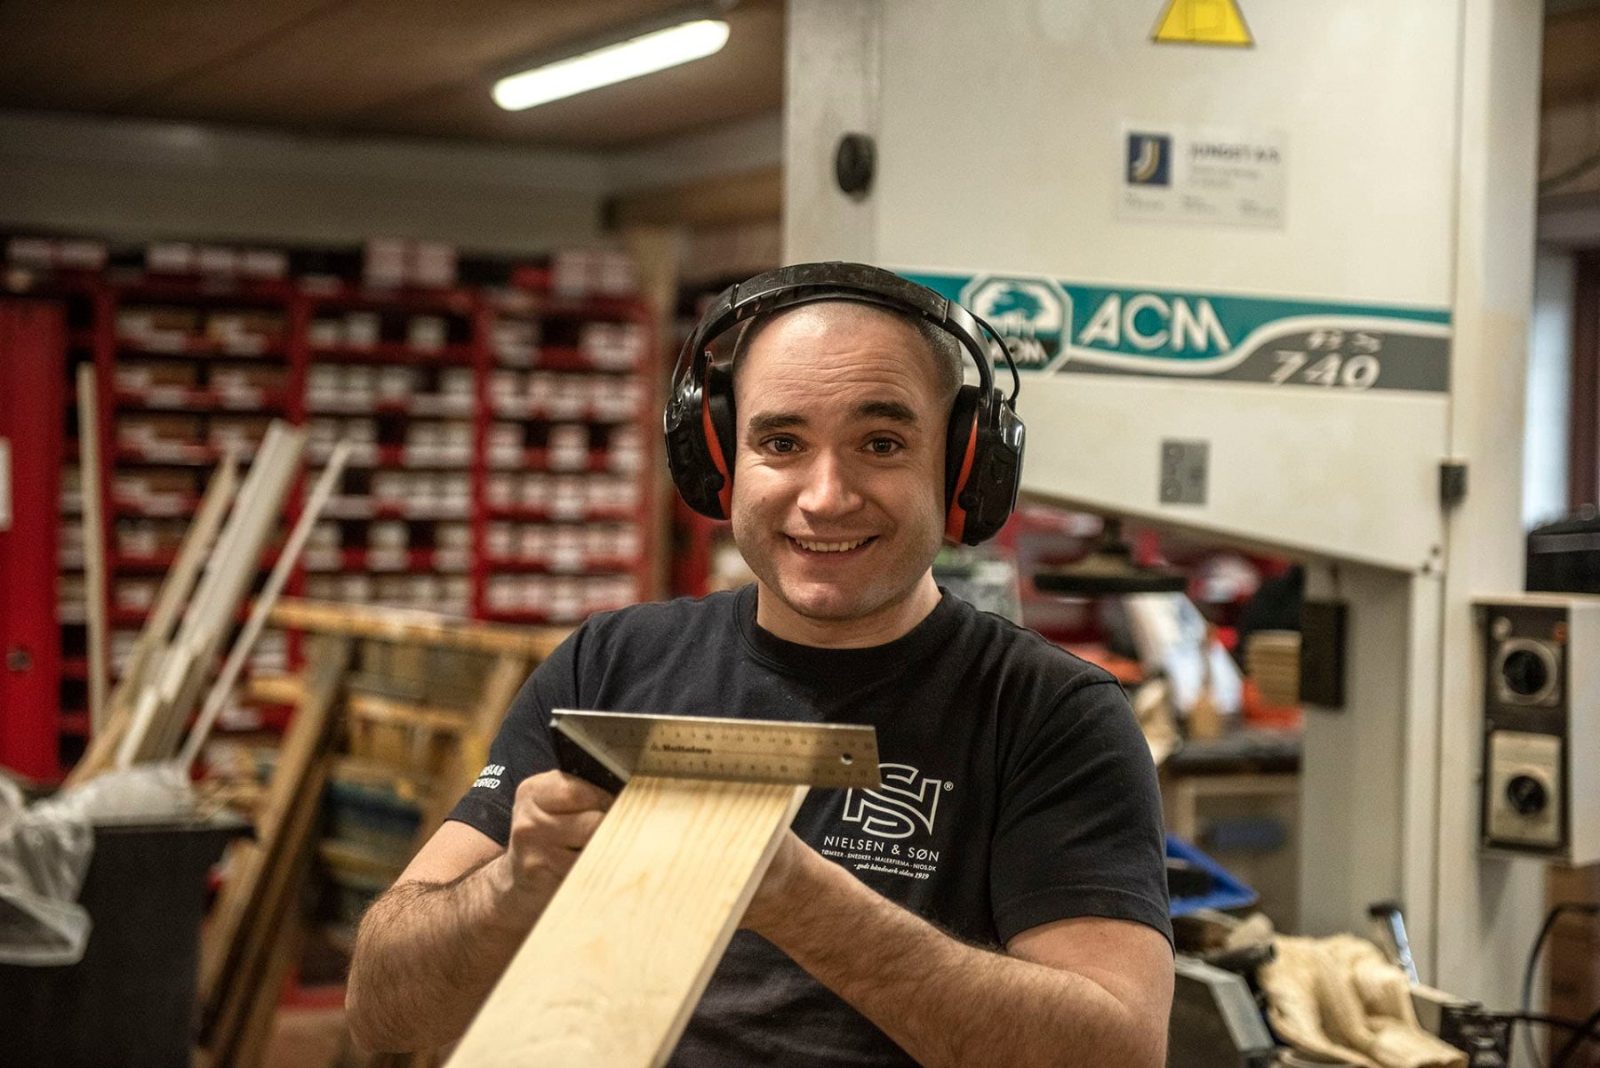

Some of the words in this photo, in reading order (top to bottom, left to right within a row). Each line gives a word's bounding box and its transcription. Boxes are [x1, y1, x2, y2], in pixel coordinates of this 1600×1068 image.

[1080, 293, 1232, 353] ACM
[1270, 351, 1380, 389] 740
[824, 836, 885, 853] NIELSEN
[891, 844, 901, 855] &
[908, 847, 940, 862] SØN
[914, 872, 930, 880] 1919
